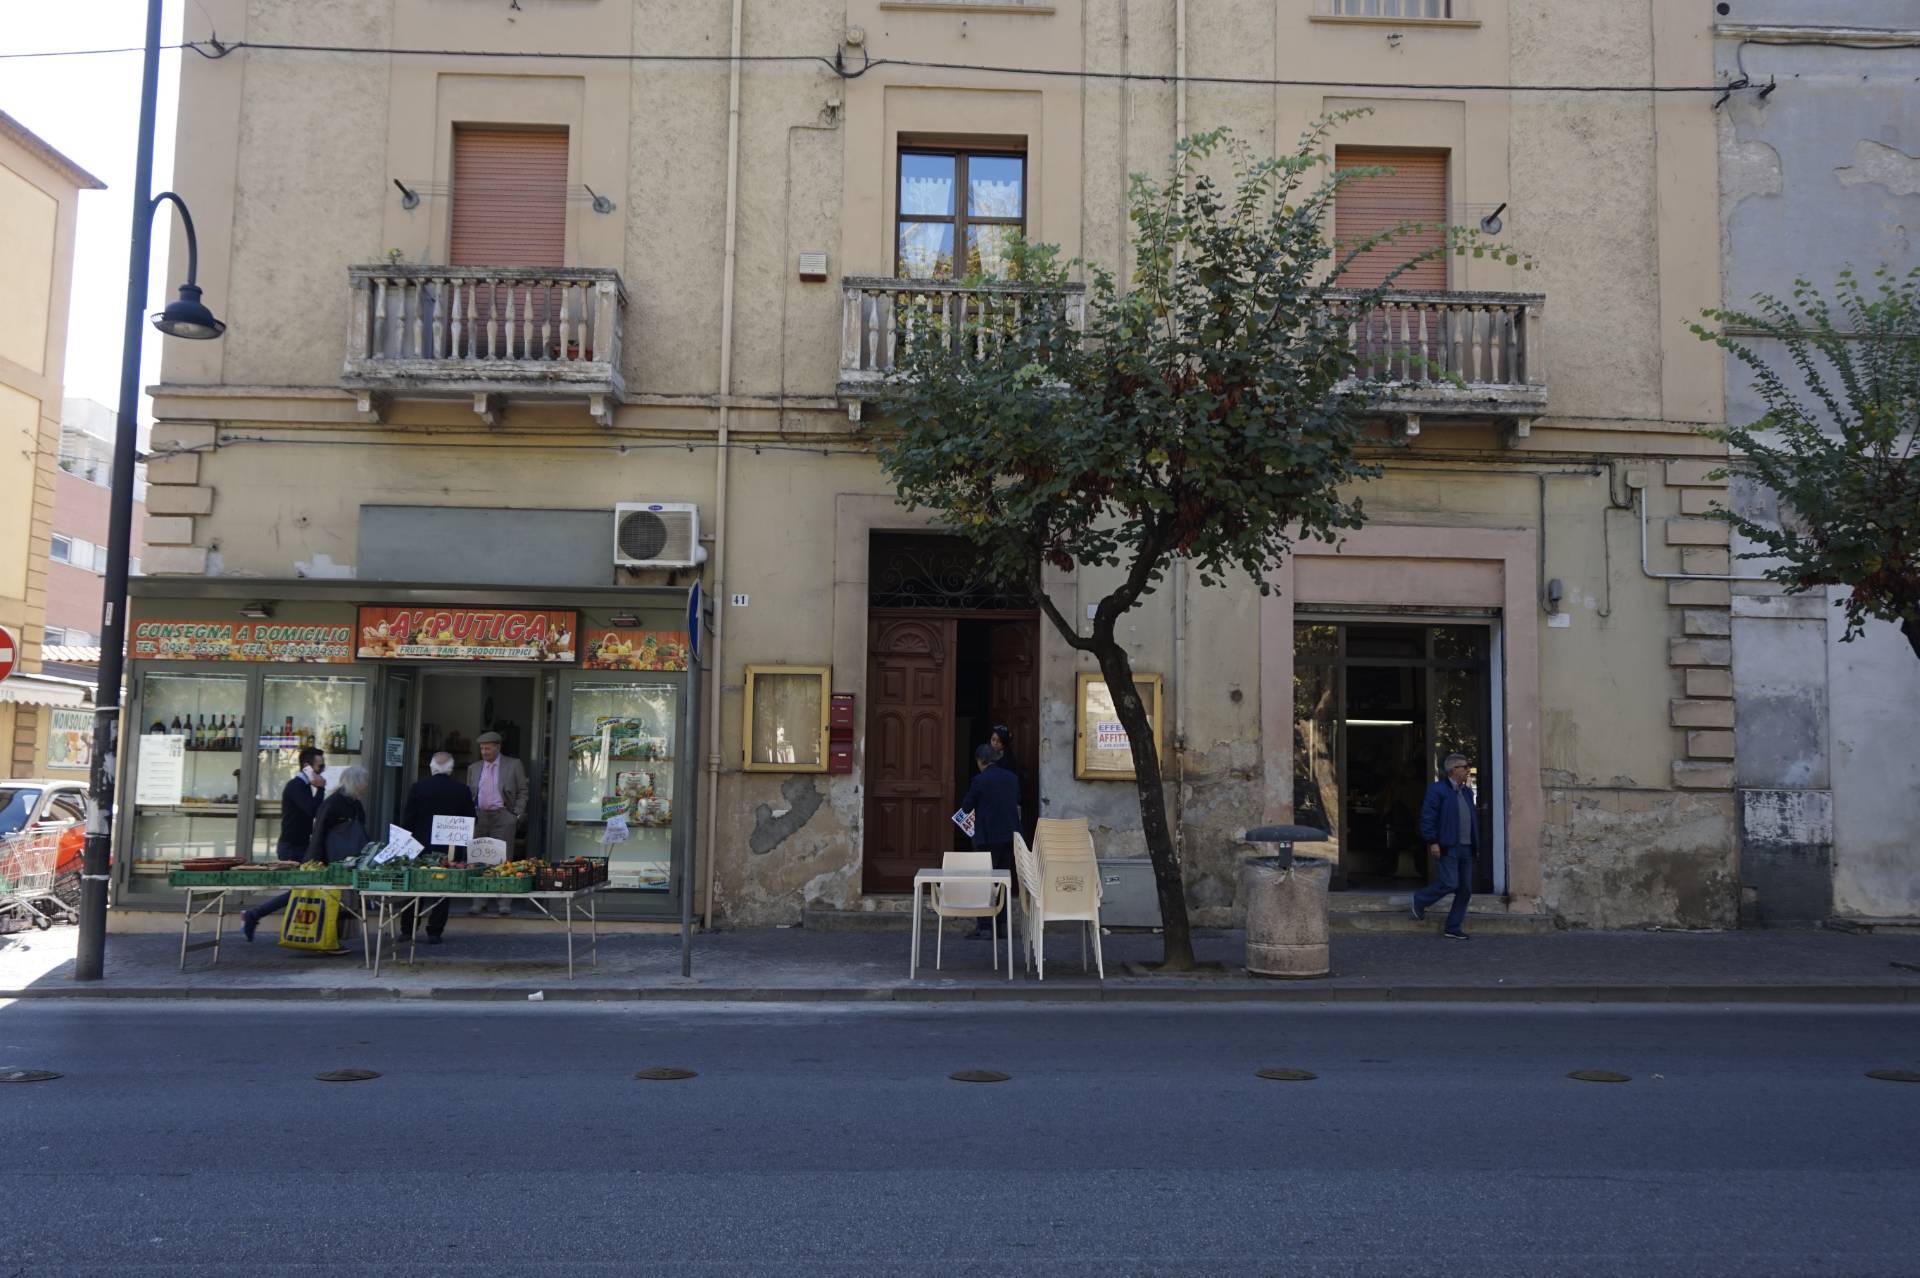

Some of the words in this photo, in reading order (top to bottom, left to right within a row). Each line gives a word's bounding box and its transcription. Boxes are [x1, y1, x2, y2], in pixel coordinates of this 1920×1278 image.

[733, 595, 745, 605] 41
[135, 623, 232, 640] CONSEGNA
[237, 625, 250, 641] A
[254, 626, 350, 642] DOMICILIO
[429, 612, 547, 641] PUTIGA
[399, 646, 429, 655] FRUTTA
[466, 647, 506, 656] PRODOTTI
